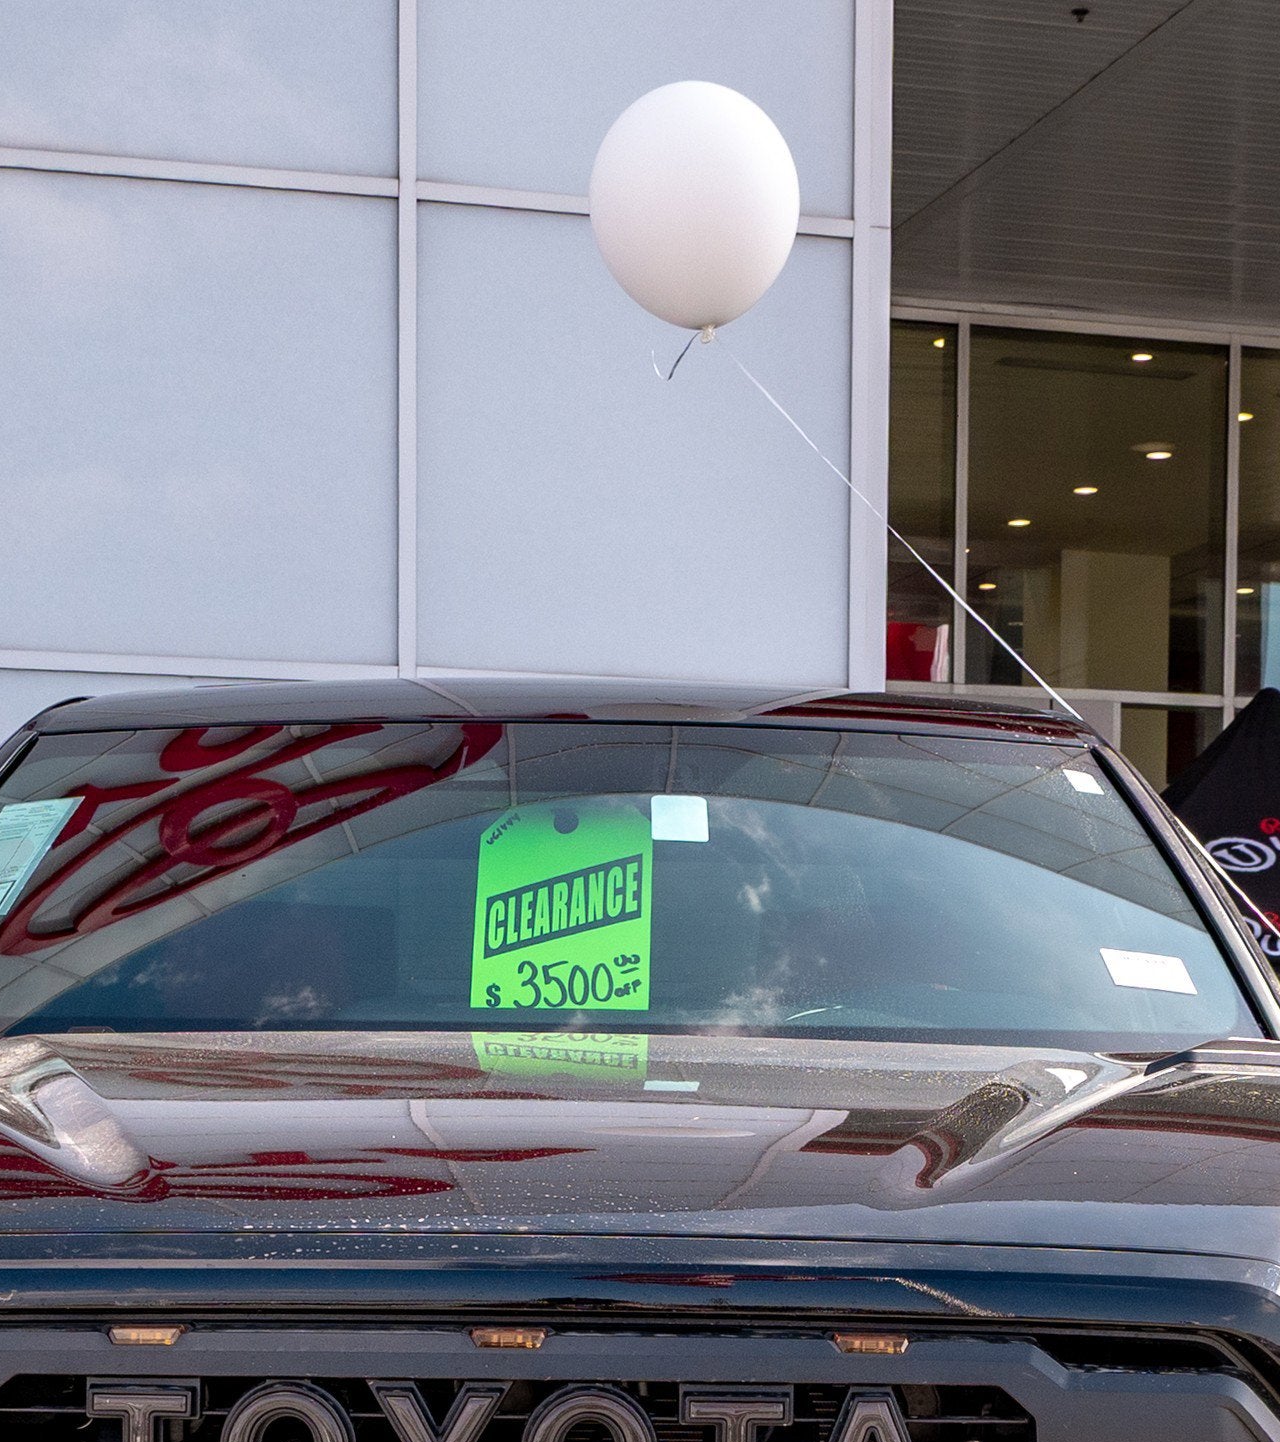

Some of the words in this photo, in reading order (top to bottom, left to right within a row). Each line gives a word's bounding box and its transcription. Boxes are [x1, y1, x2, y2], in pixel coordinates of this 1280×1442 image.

[487, 861, 639, 950] CLEARANCE
[486, 983, 501, 1007] $
[513, 960, 613, 1009] 3500
